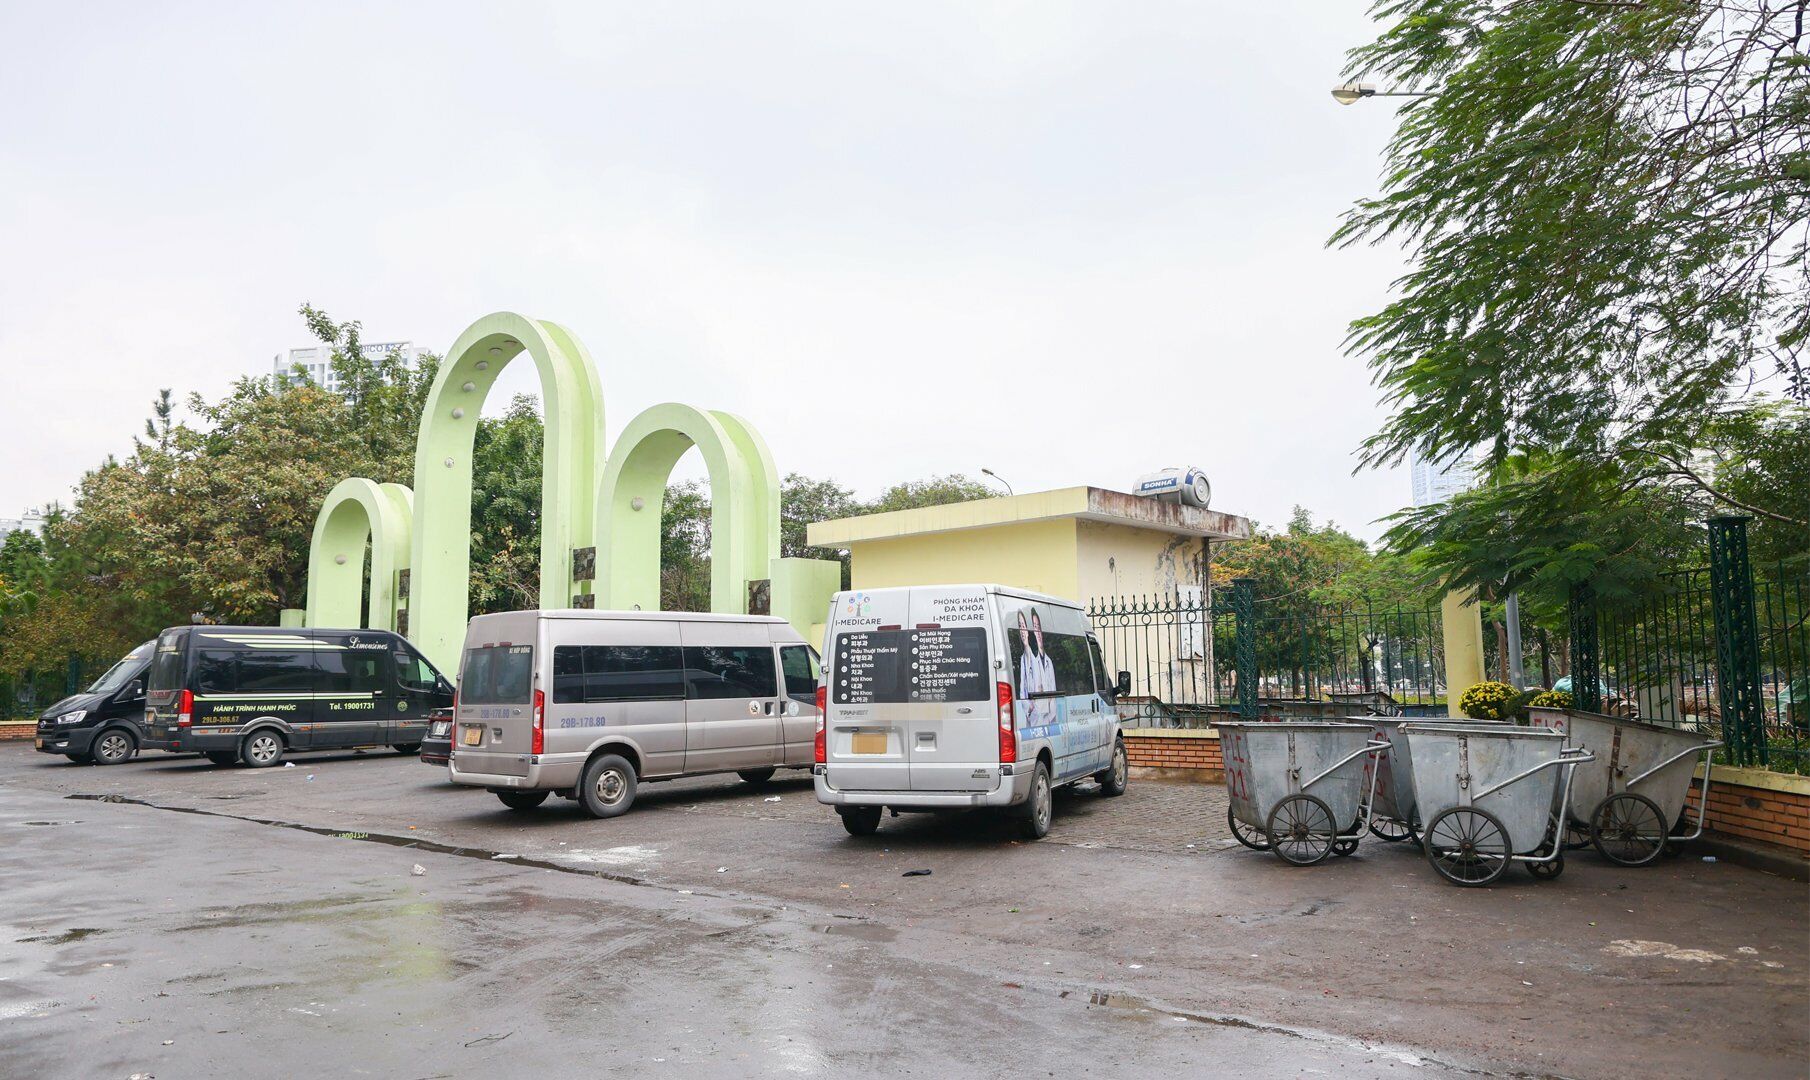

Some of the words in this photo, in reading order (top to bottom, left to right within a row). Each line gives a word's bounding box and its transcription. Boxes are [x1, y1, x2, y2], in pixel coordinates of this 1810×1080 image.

[962, 596, 985, 604] KHÁM
[933, 613, 985, 622] I-MEDICARE
[835, 618, 882, 626] I-MEDICARE
[348, 636, 388, 650] Limousines
[919, 636, 950, 644] 이비인후과
[919, 650, 943, 658] 산부인과
[213, 704, 234, 712] HÀNH
[235, 704, 256, 712] TRÌNH
[256, 705, 277, 713] HẠNH
[343, 702, 375, 710] 19001731
[1229, 767, 1249, 801] 21
